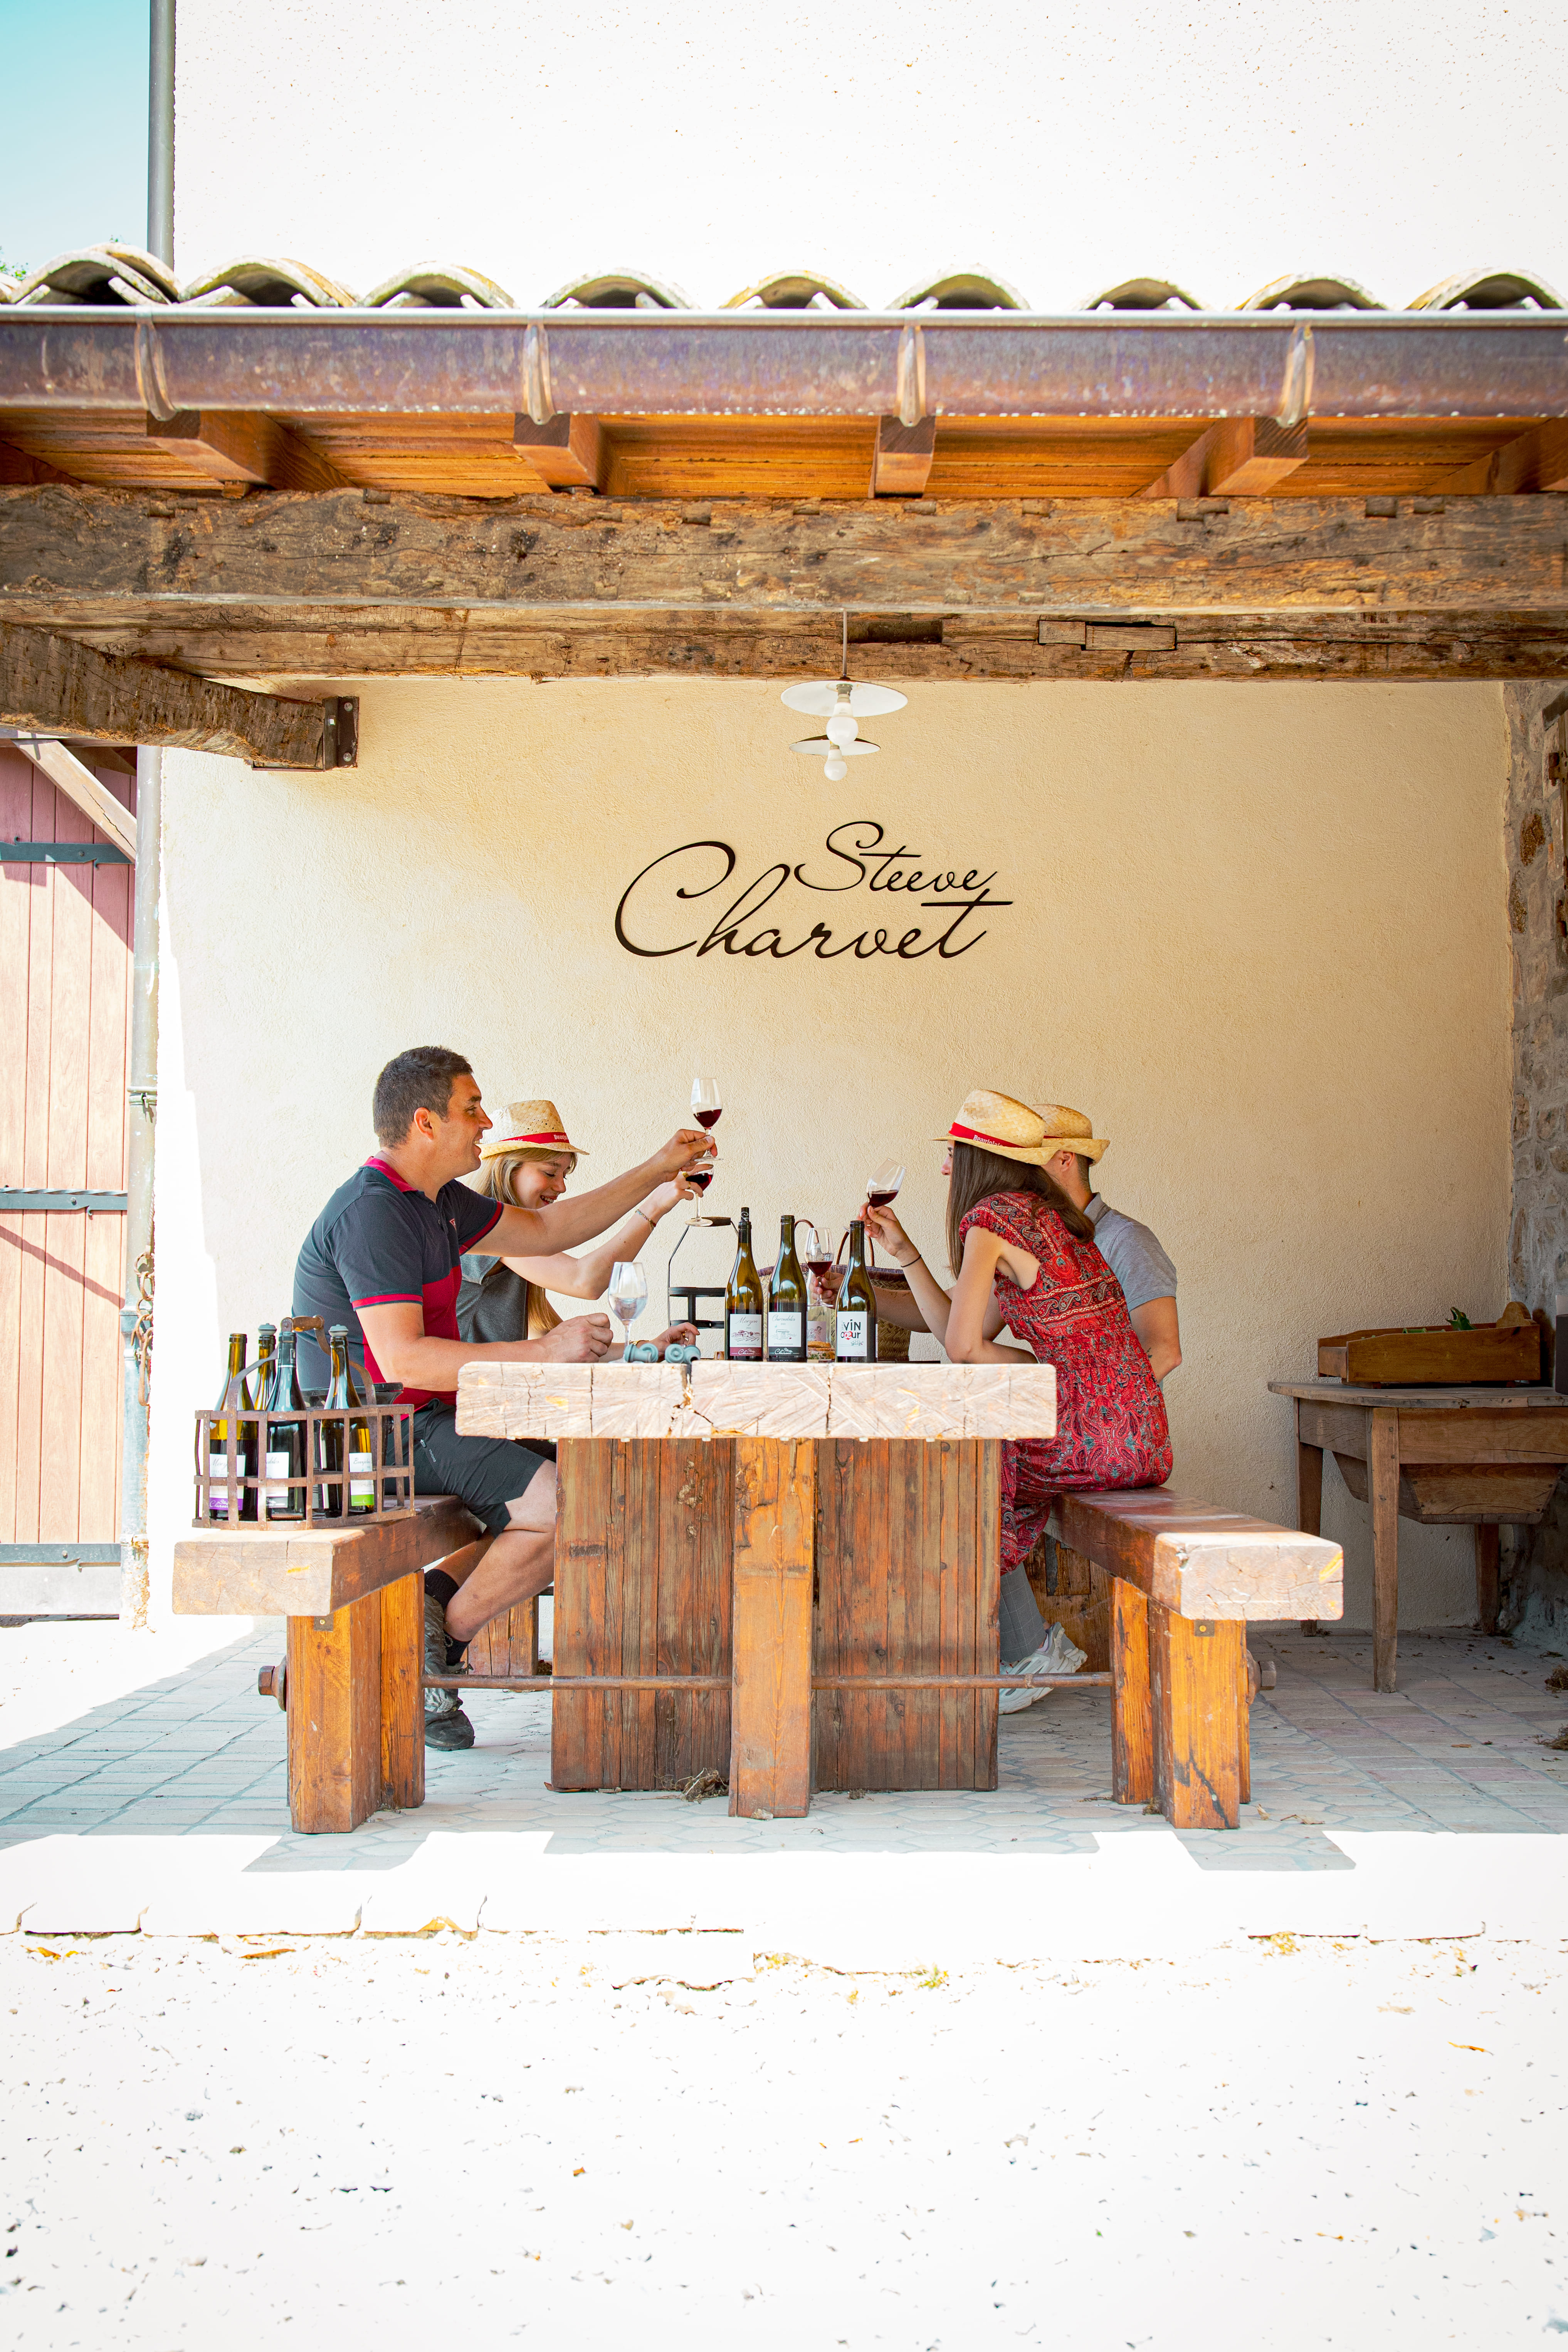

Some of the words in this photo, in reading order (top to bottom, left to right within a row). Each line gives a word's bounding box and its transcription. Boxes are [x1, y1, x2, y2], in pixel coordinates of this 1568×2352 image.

[794, 821, 998, 893] Steeve
[615, 841, 1013, 959] Charvet
[735, 1316, 758, 1326] Morgon
